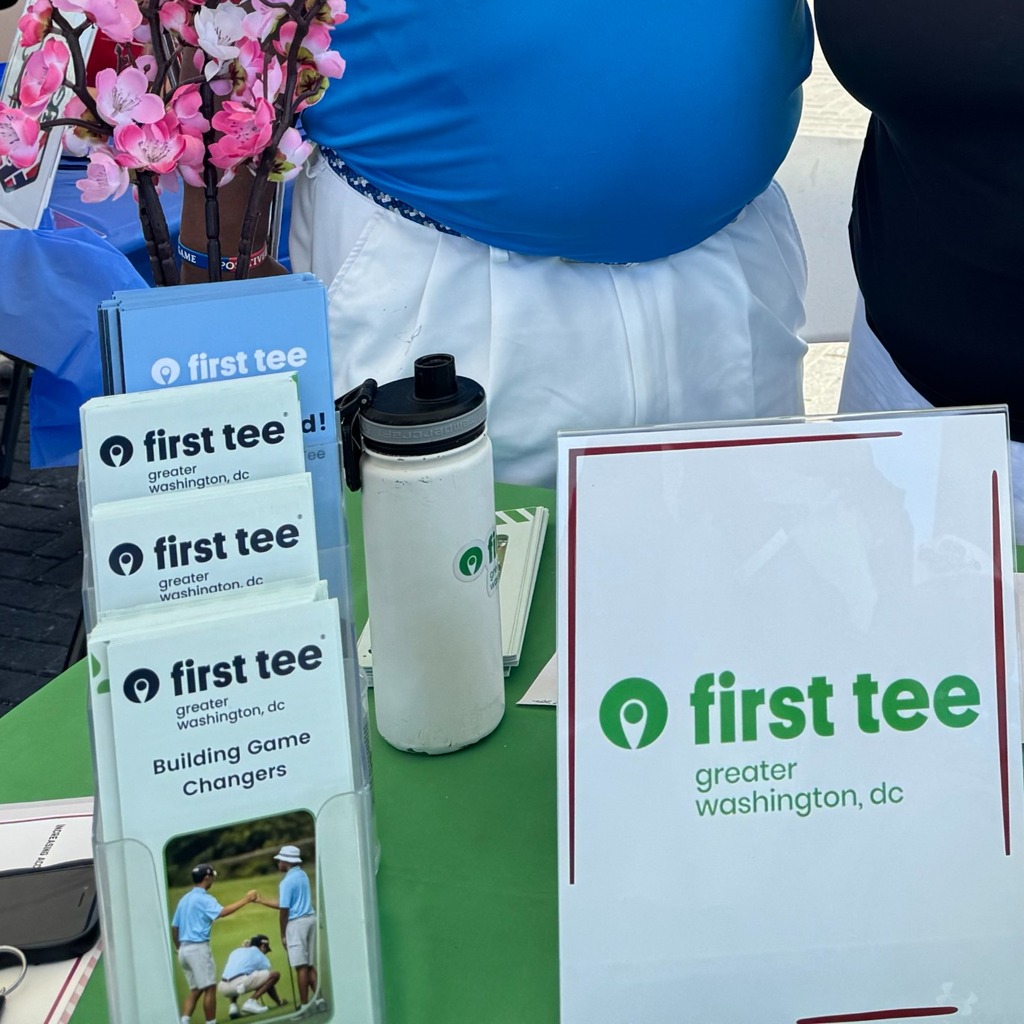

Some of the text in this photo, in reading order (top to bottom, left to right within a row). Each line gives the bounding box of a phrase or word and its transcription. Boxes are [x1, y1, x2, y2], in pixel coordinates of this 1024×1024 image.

[187, 346, 308, 382] first tee
[143, 420, 286, 463] first tee
[148, 464, 198, 484] greater
[149, 469, 250, 494] washington, dc
[154, 523, 300, 571] first tee
[158, 571, 210, 592] greater
[246, 575, 264, 588] dc
[171, 643, 323, 697] first tee
[176, 697, 229, 719] greater
[177, 699, 286, 730] washington, dc
[690, 670, 981, 745] first tee
[153, 731, 311, 775] Building Game
[183, 764, 287, 796] Changers
[695, 759, 798, 793] greater
[695, 781, 905, 818] washington, dc
